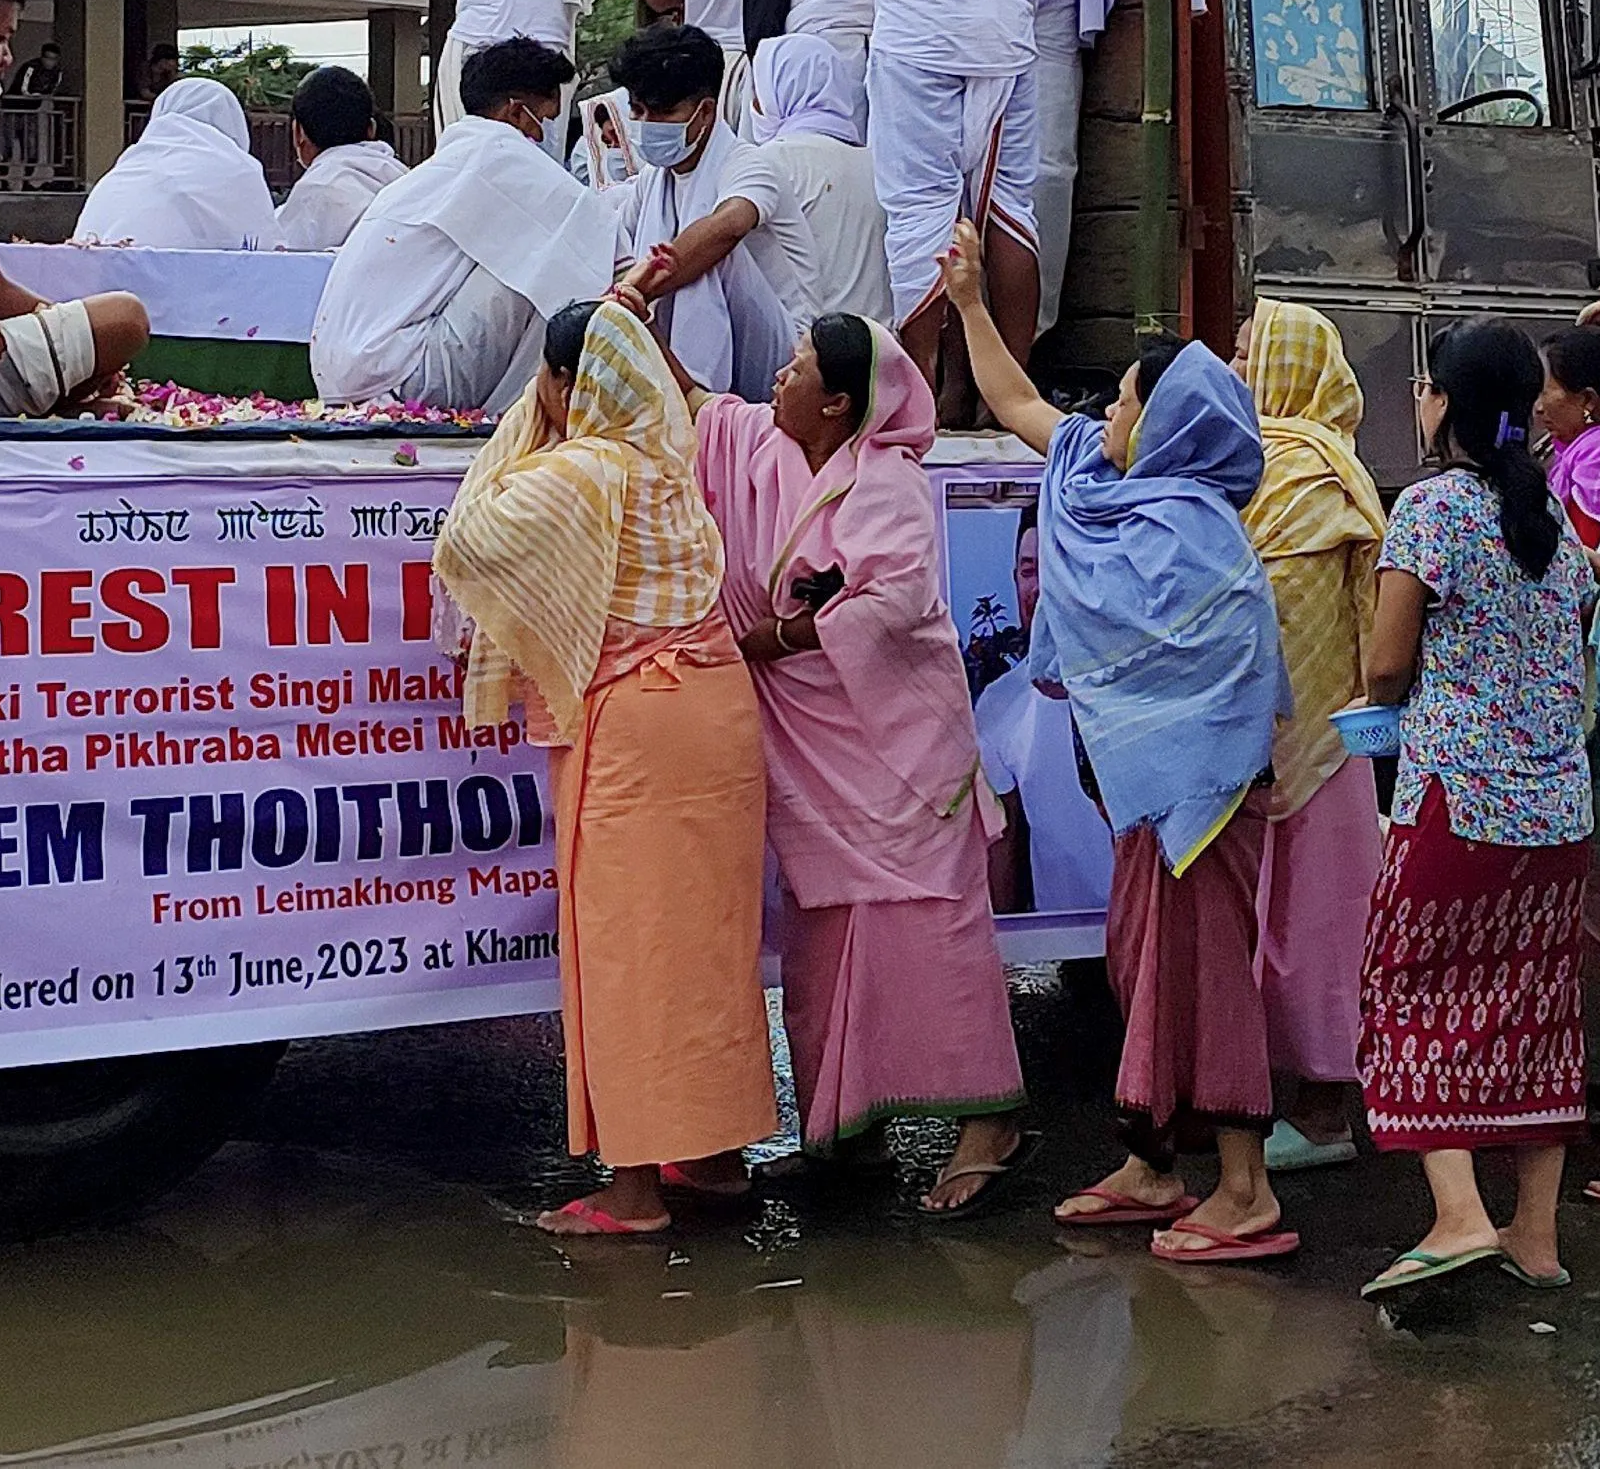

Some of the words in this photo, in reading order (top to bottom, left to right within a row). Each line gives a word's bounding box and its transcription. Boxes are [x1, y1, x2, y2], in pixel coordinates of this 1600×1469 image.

[265, 563, 371, 647] IN
[36, 677, 235, 718] Terrorist
[249, 669, 353, 715] Singi
[85, 726, 282, 770] Pikhraba
[297, 716, 425, 758] Meitei
[438, 715, 529, 756] Map
[130, 773, 542, 877] THOITHOI
[152, 892, 242, 924] From
[256, 875, 456, 916] Leimakhong
[92, 971, 135, 1002] on
[152, 954, 217, 996] 13th
[228, 935, 409, 997] June,2023
[423, 937, 455, 971] at
